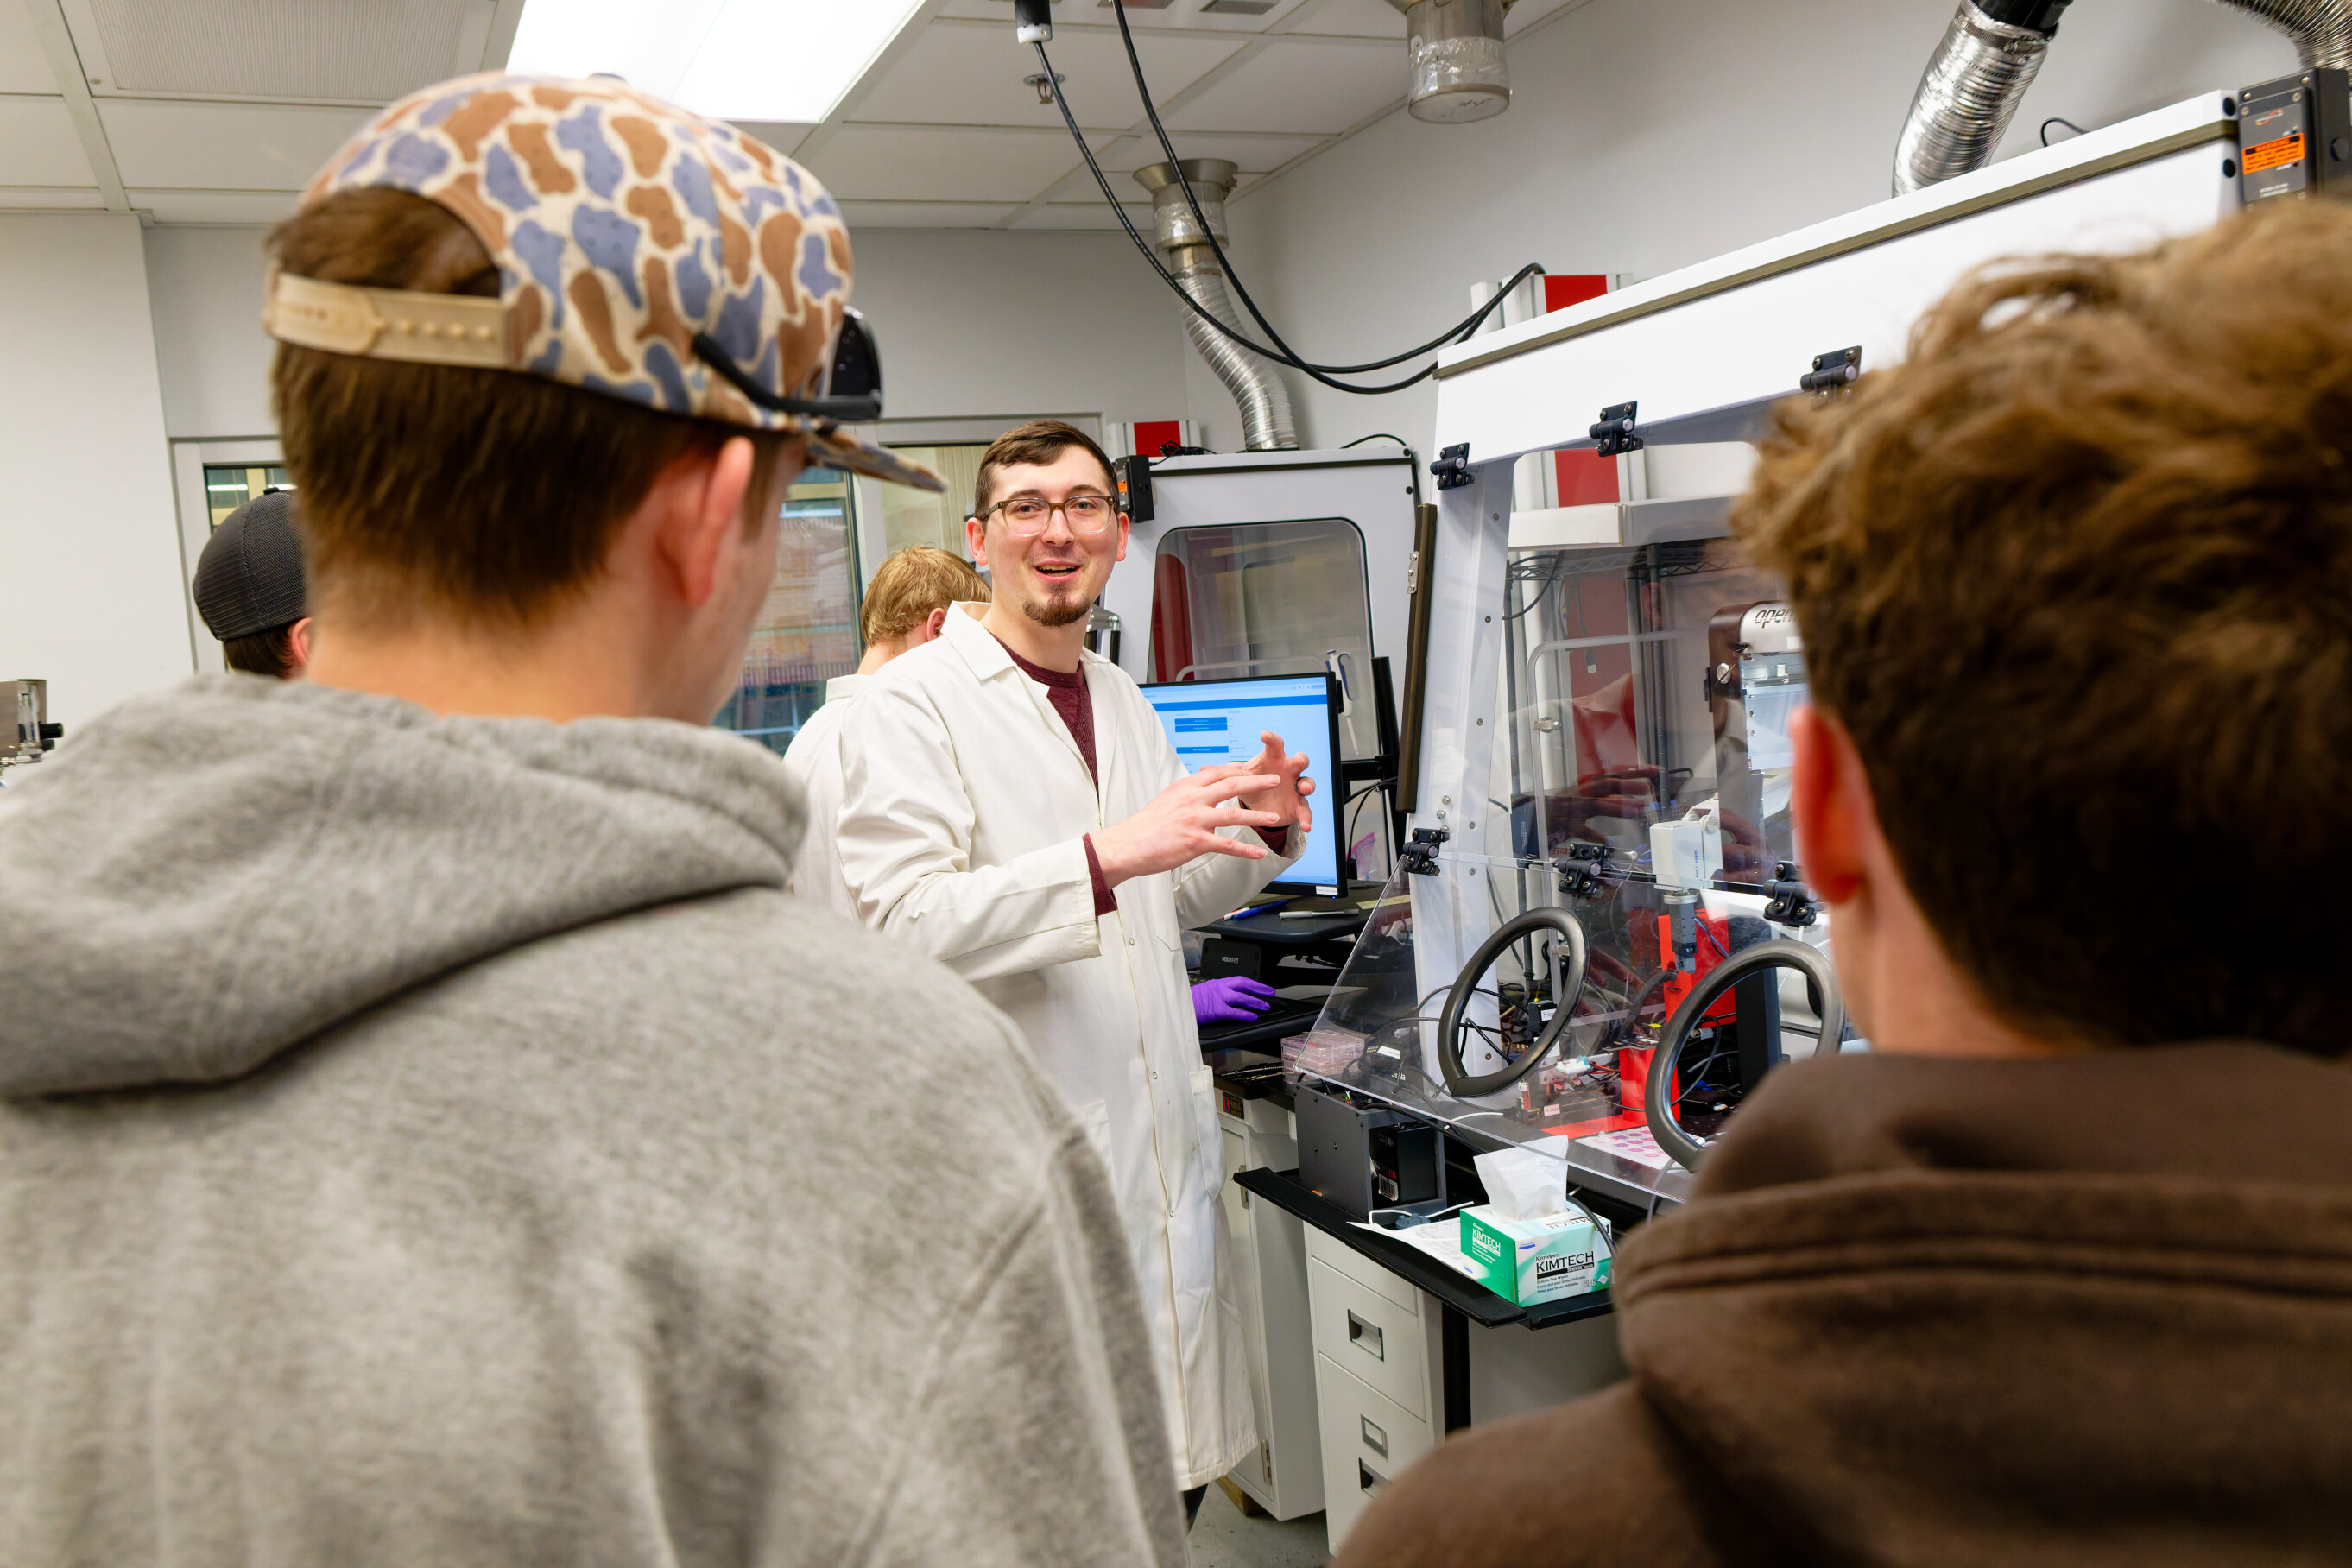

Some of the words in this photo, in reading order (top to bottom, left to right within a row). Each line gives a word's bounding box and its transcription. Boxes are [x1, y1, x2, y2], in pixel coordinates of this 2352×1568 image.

[1472, 1228, 1501, 1252] KIMTECH
[1536, 1253, 1559, 1261] Kimwipes
[1536, 1251, 1594, 1273] KIMTECH
